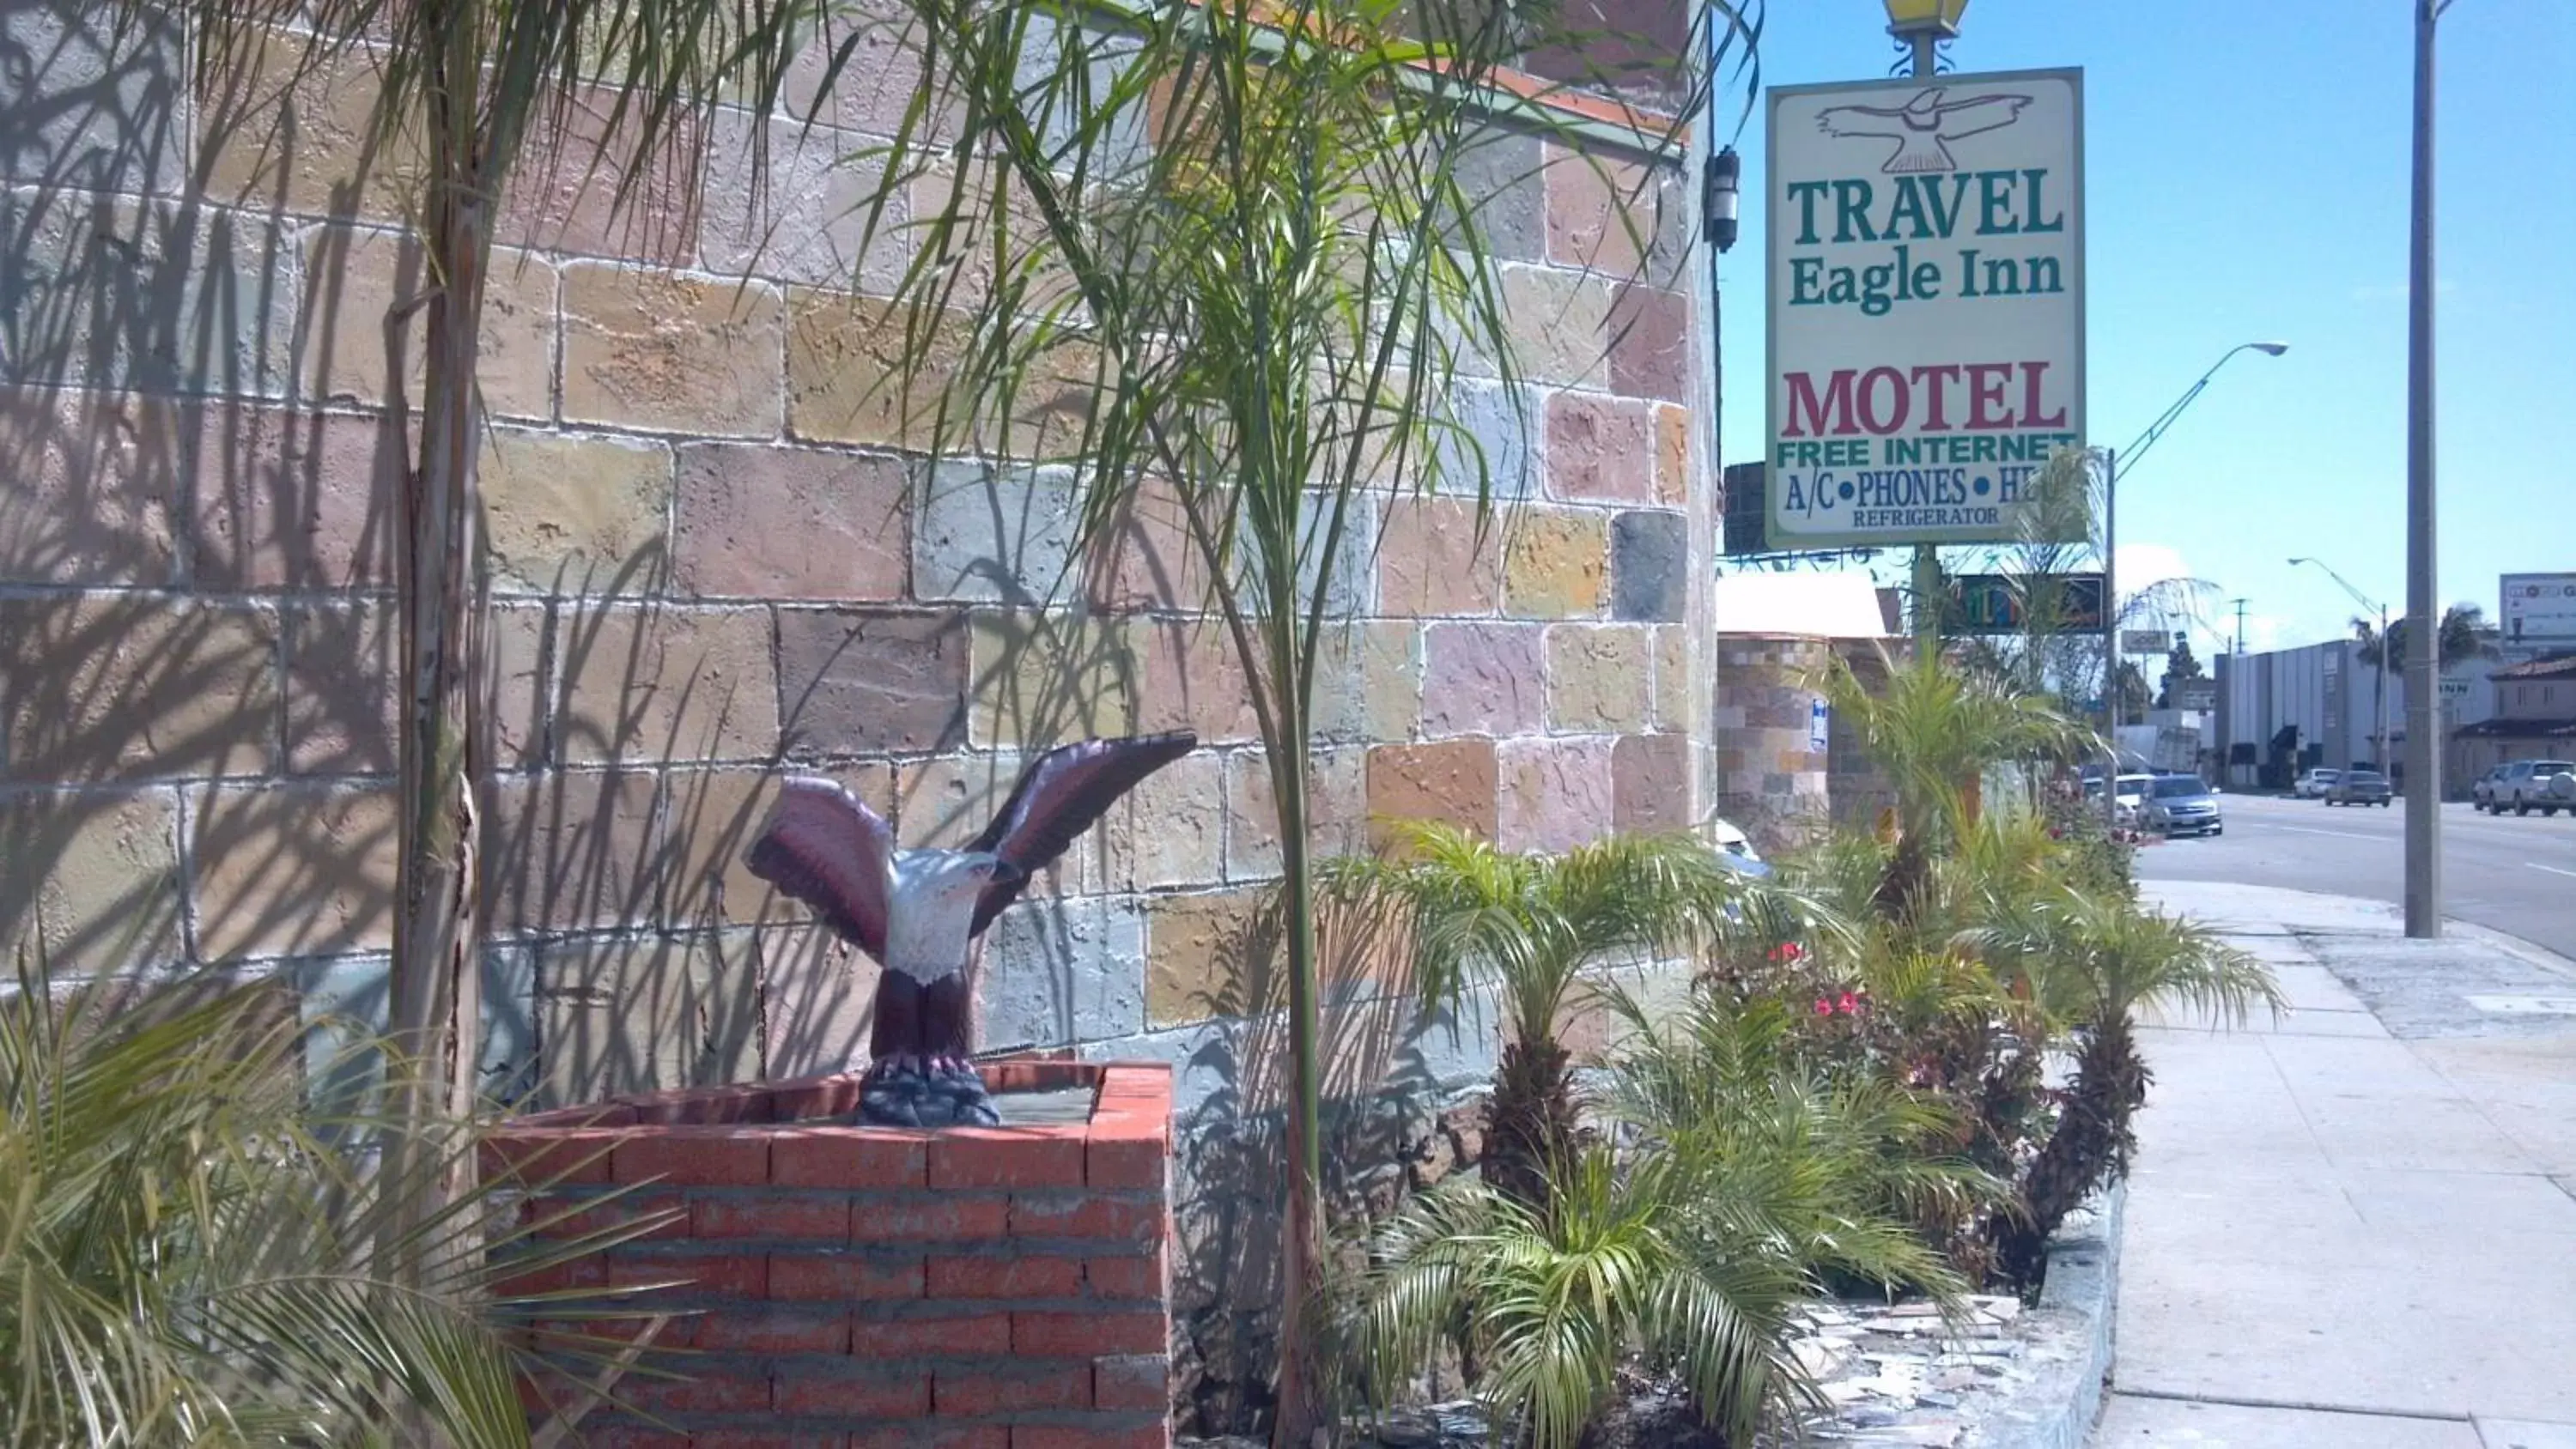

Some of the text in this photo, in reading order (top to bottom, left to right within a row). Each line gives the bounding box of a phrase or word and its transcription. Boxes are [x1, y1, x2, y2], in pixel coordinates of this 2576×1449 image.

[1788, 168, 2064, 245] TRAVEL
[1788, 246, 2064, 317] Eagle Inn
[1783, 361, 2067, 438] MOTEL
[1777, 433, 2077, 469] FREE INTERNET
[1784, 462, 1835, 518] A/C
[1856, 468, 1967, 507] PHONES
[1852, 507, 2000, 528] REFRIGERATOR
